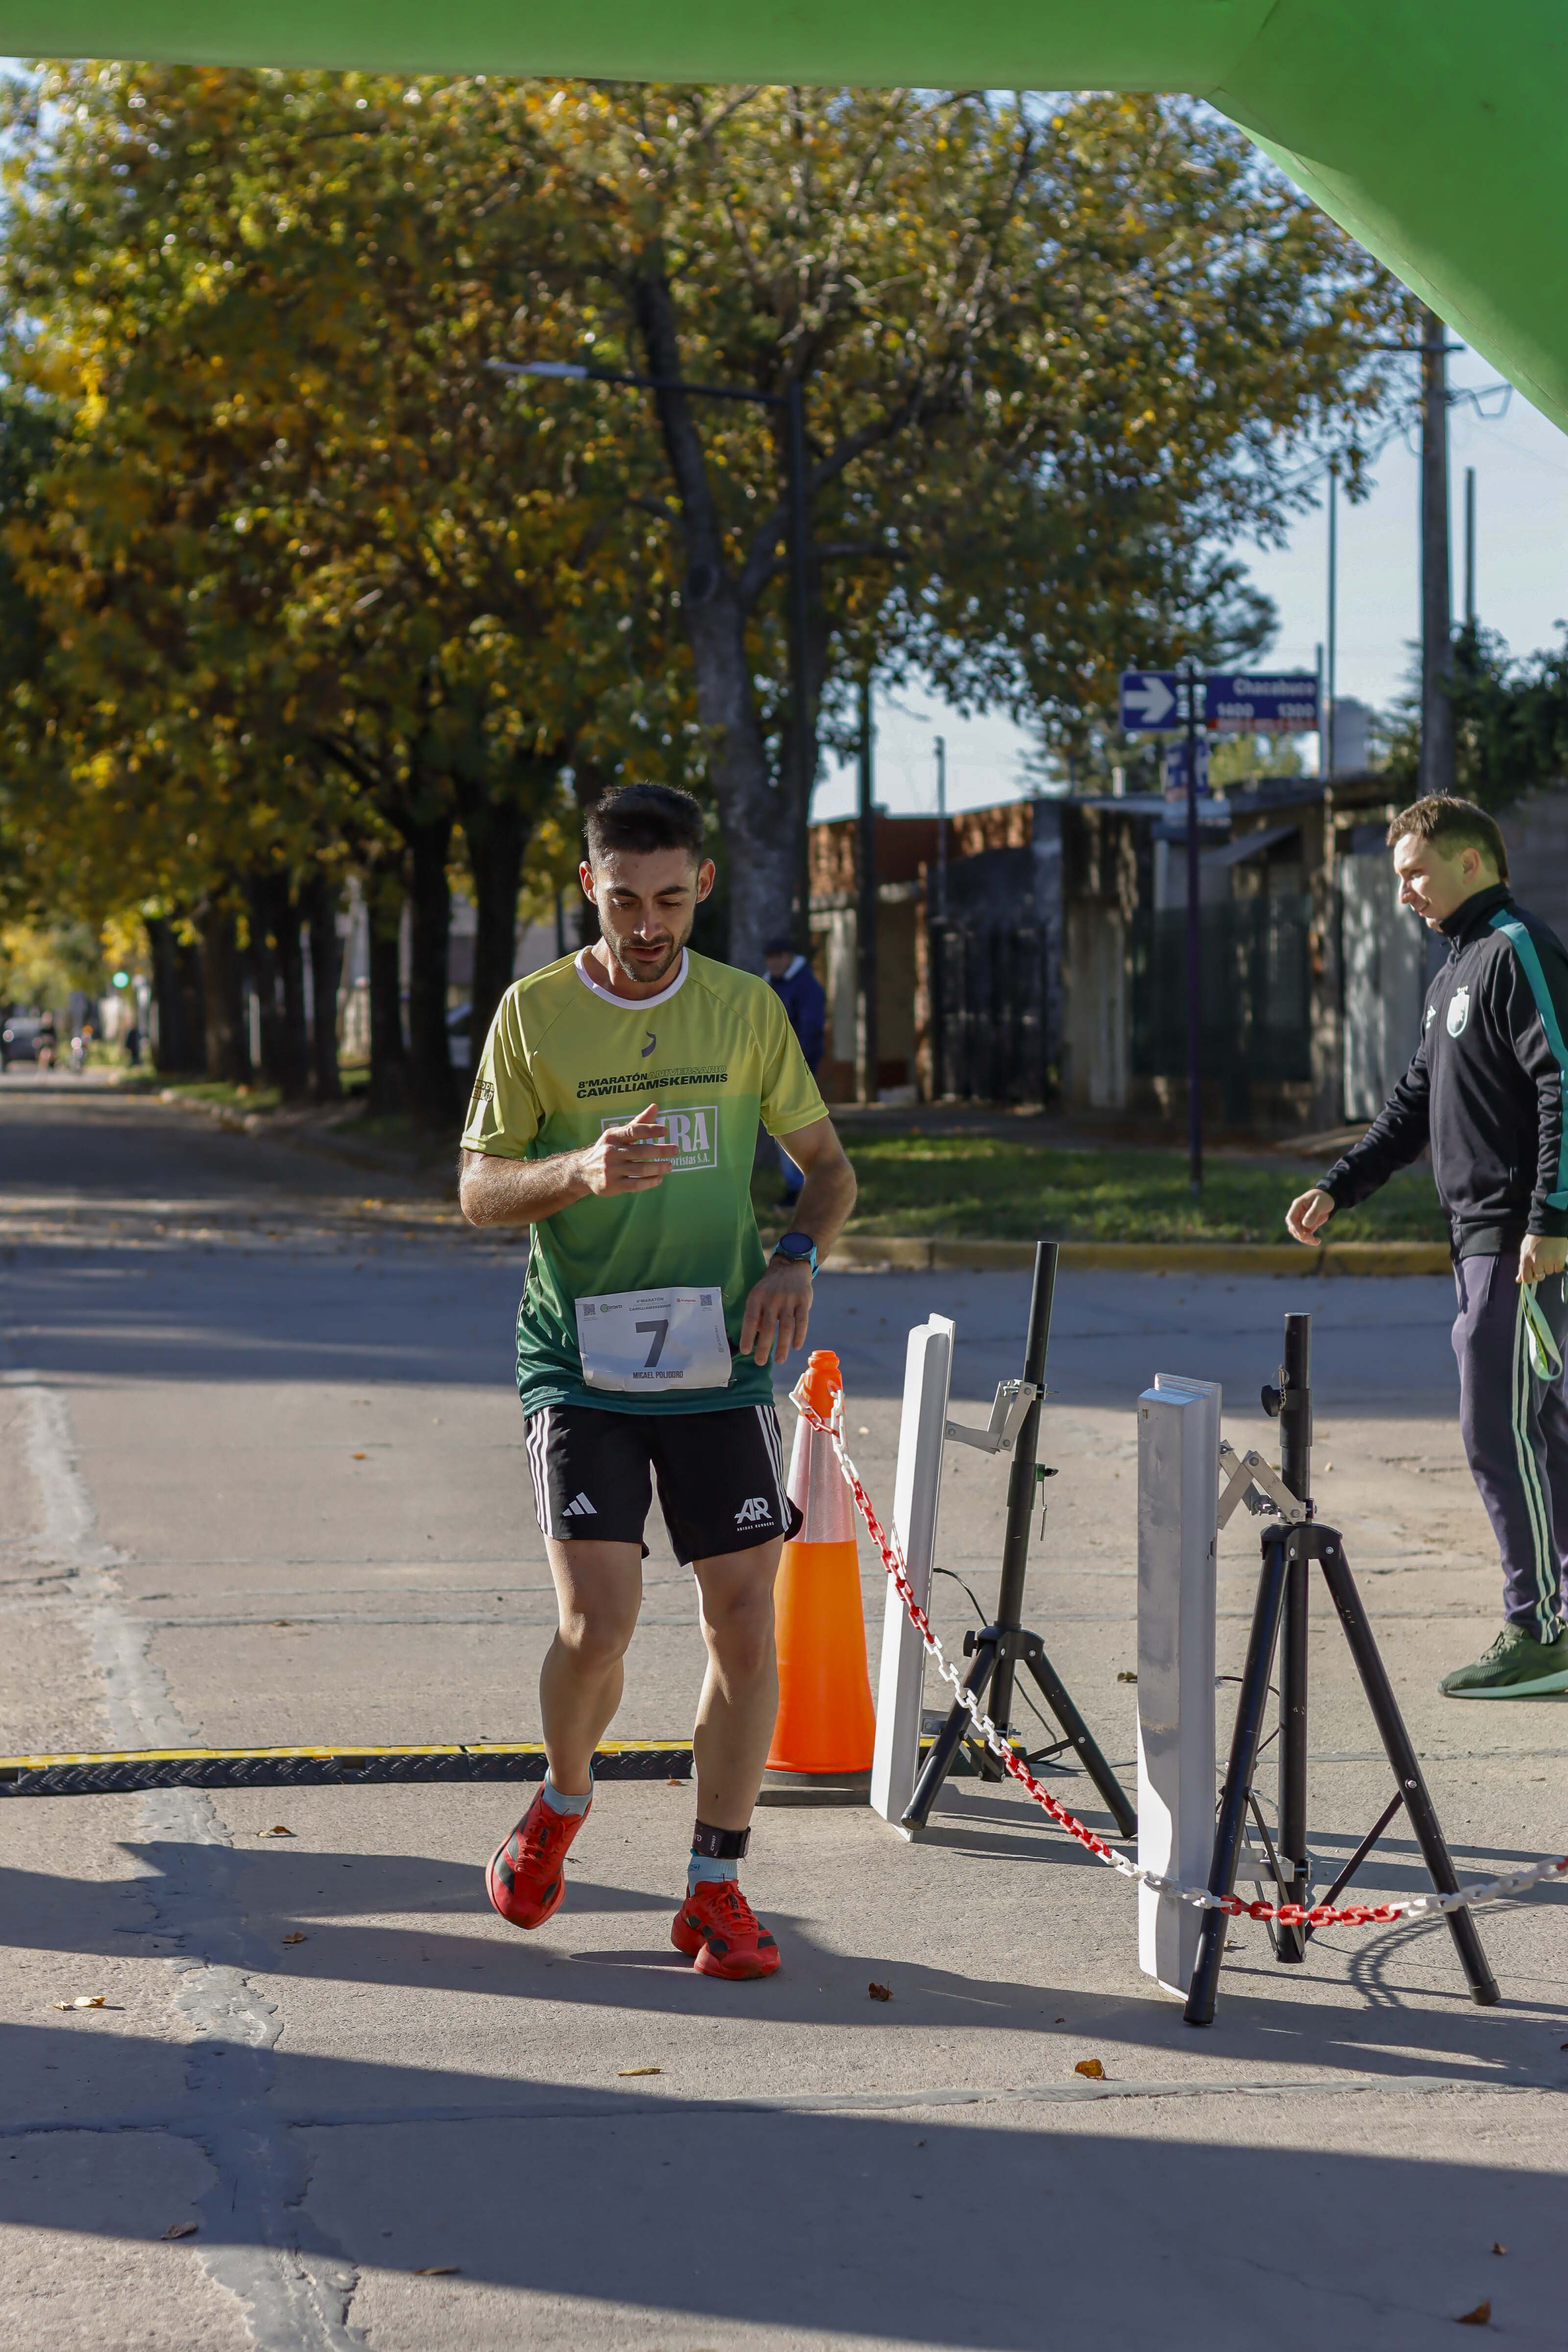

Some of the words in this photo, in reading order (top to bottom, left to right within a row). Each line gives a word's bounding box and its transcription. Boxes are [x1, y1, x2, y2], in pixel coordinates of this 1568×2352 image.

[698, 1152, 710, 1163] S.A.
[635, 1319, 669, 1368] 7
[656, 1371, 684, 1379] POLIDORO
[734, 1497, 773, 1524] AR
